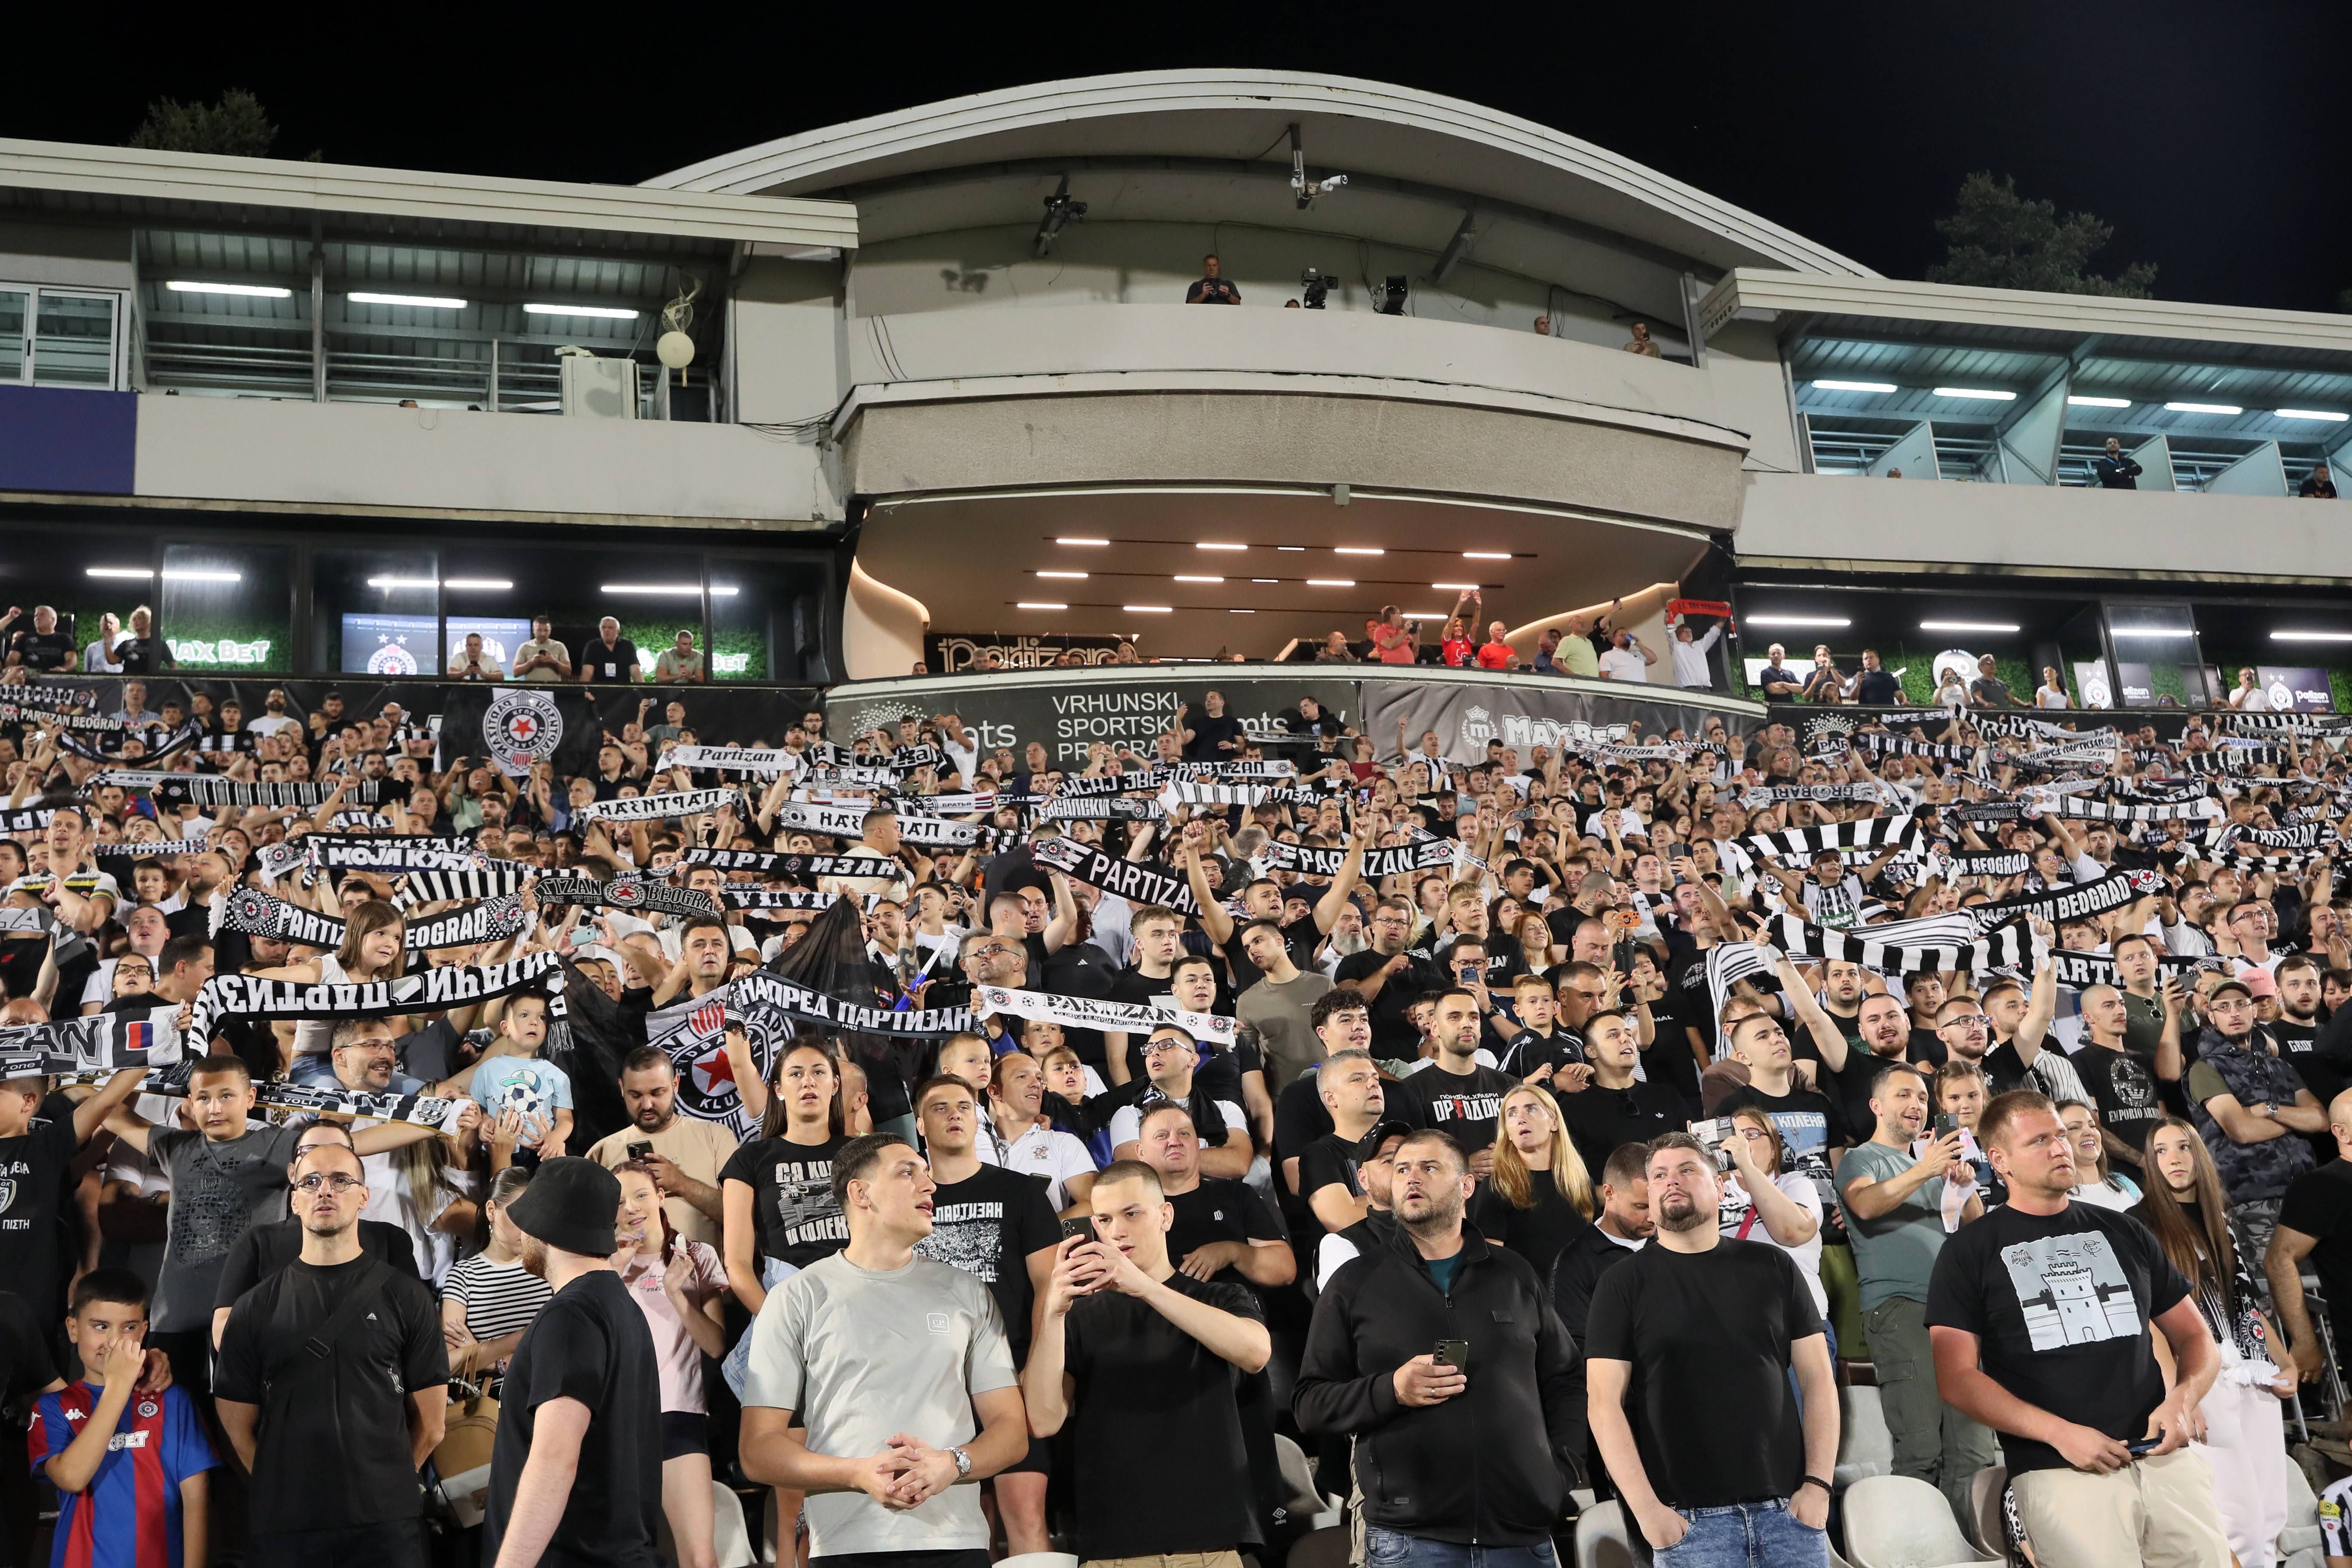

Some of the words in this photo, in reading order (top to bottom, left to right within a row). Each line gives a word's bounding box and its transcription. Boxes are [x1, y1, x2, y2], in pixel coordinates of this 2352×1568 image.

[1053, 692, 1178, 714] VRHUNSKI
[20, 707, 70, 727] PARZAN
[72, 715, 123, 731] BEOGRAD
[1057, 716, 1177, 738] SPORTSKI
[698, 748, 776, 763] Partizan
[1058, 740, 1158, 761] PRGRA
[1299, 847, 1415, 876] PARIZAN
[1971, 852, 2029, 875] BEOGRAD
[572, 895, 603, 904] THE
[647, 885, 715, 913] BEOGRA
[2056, 875, 2132, 919] BEOGRAD
[276, 903, 346, 946] PARTIZ
[406, 906, 487, 948] EOGRAD
[738, 977, 831, 1020] НАПРЕД
[836, 1001, 974, 1032] ПАРТИЗАН
[1043, 993, 1179, 1023] PARTIZAN
[9, 1061, 35, 1070] one
[284, 1097, 312, 1106] VOLI
[1432, 1098, 1504, 1122] ОРТОДОК
[2108, 1108, 2143, 1123] EMPORIO
[775, 1161, 804, 1183] СА
[808, 1160, 833, 1179] КОЛ
[799, 1215, 850, 1242] КОЛЕН
